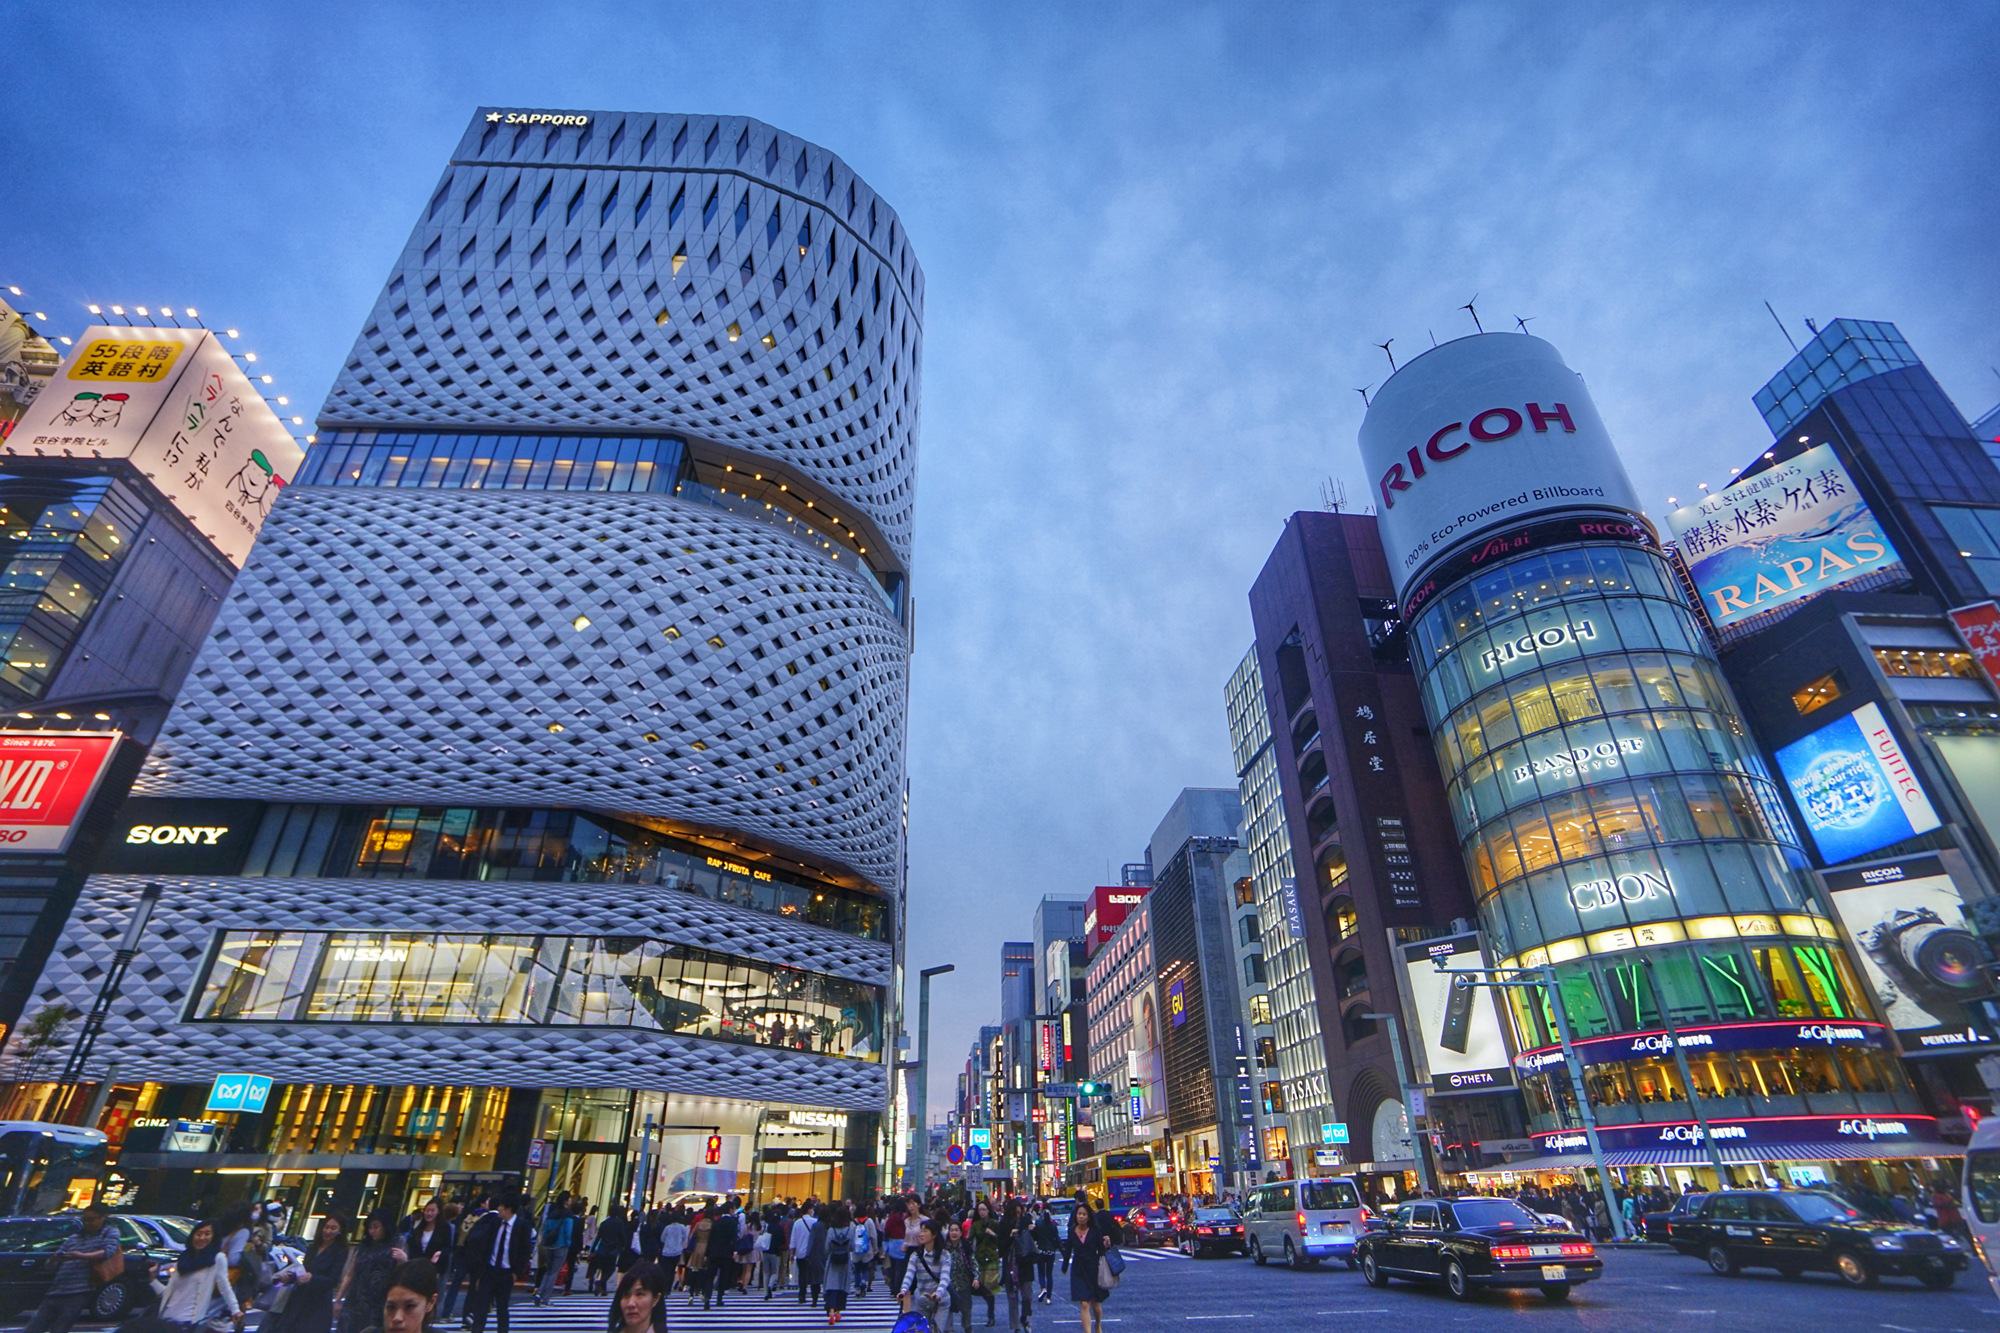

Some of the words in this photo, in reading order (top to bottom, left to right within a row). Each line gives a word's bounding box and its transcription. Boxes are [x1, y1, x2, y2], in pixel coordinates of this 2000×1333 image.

[505, 113, 588, 126] SAPPORO
[91, 344, 174, 360] 55段階
[79, 361, 162, 378] 英語村
[33, 436, 110, 447] 四谷学院ビル
[184, 396, 244, 490] なんで、私が
[1379, 402, 1576, 509] RICOH
[1698, 466, 1802, 518] 美しさは健康から
[1404, 540, 1430, 570] 100%
[1431, 492, 1529, 545] Eco-Powered
[1532, 486, 1605, 502] Billboard
[1580, 523, 1642, 537] RICOH
[1709, 529, 1886, 618] RAPAS
[1481, 620, 1596, 672] RICOH
[3, 739, 31, 747] Since
[32, 739, 57, 747] 1876.
[1356, 705, 1385, 772] 鳩居堂
[1513, 747, 1590, 783] BRAND
[1596, 737, 1644, 757] OFF
[1552, 757, 1617, 780] TOKYO
[1873, 729, 1922, 804] FUJITEC
[1791, 768, 1822, 789] World
[1797, 783, 1822, 799] Love
[1822, 770, 1851, 792] your
[126, 825, 229, 845] SONY
[753, 870, 773, 882] CAFE
[1861, 866, 1903, 879] RICOH
[1284, 883, 1300, 931] TASAKI
[334, 947, 408, 962] NISSAN
[1428, 943, 1453, 953] RICOH
[1171, 992, 1184, 1015] GU
[1631, 1036, 1646, 1051] Le
[1645, 1035, 1673, 1054] Café
[1797, 1026, 1811, 1040] Le
[1810, 1025, 1836, 1045] Café
[1920, 1032, 1967, 1046] PENTAX
[1282, 1074, 1327, 1103] TASAKI
[1462, 1073, 1494, 1085] THETA
[134, 1117, 170, 1127] GINZ
[788, 1110, 848, 1128] NISSAN
[1659, 1127, 1675, 1141] Le
[1674, 1125, 1704, 1146] Café
[1709, 1126, 1747, 1139] OUTOR
[1838, 1120, 1852, 1134] Le
[1851, 1119, 1877, 1141] Café
[809, 1149, 844, 1158] CROSSING
